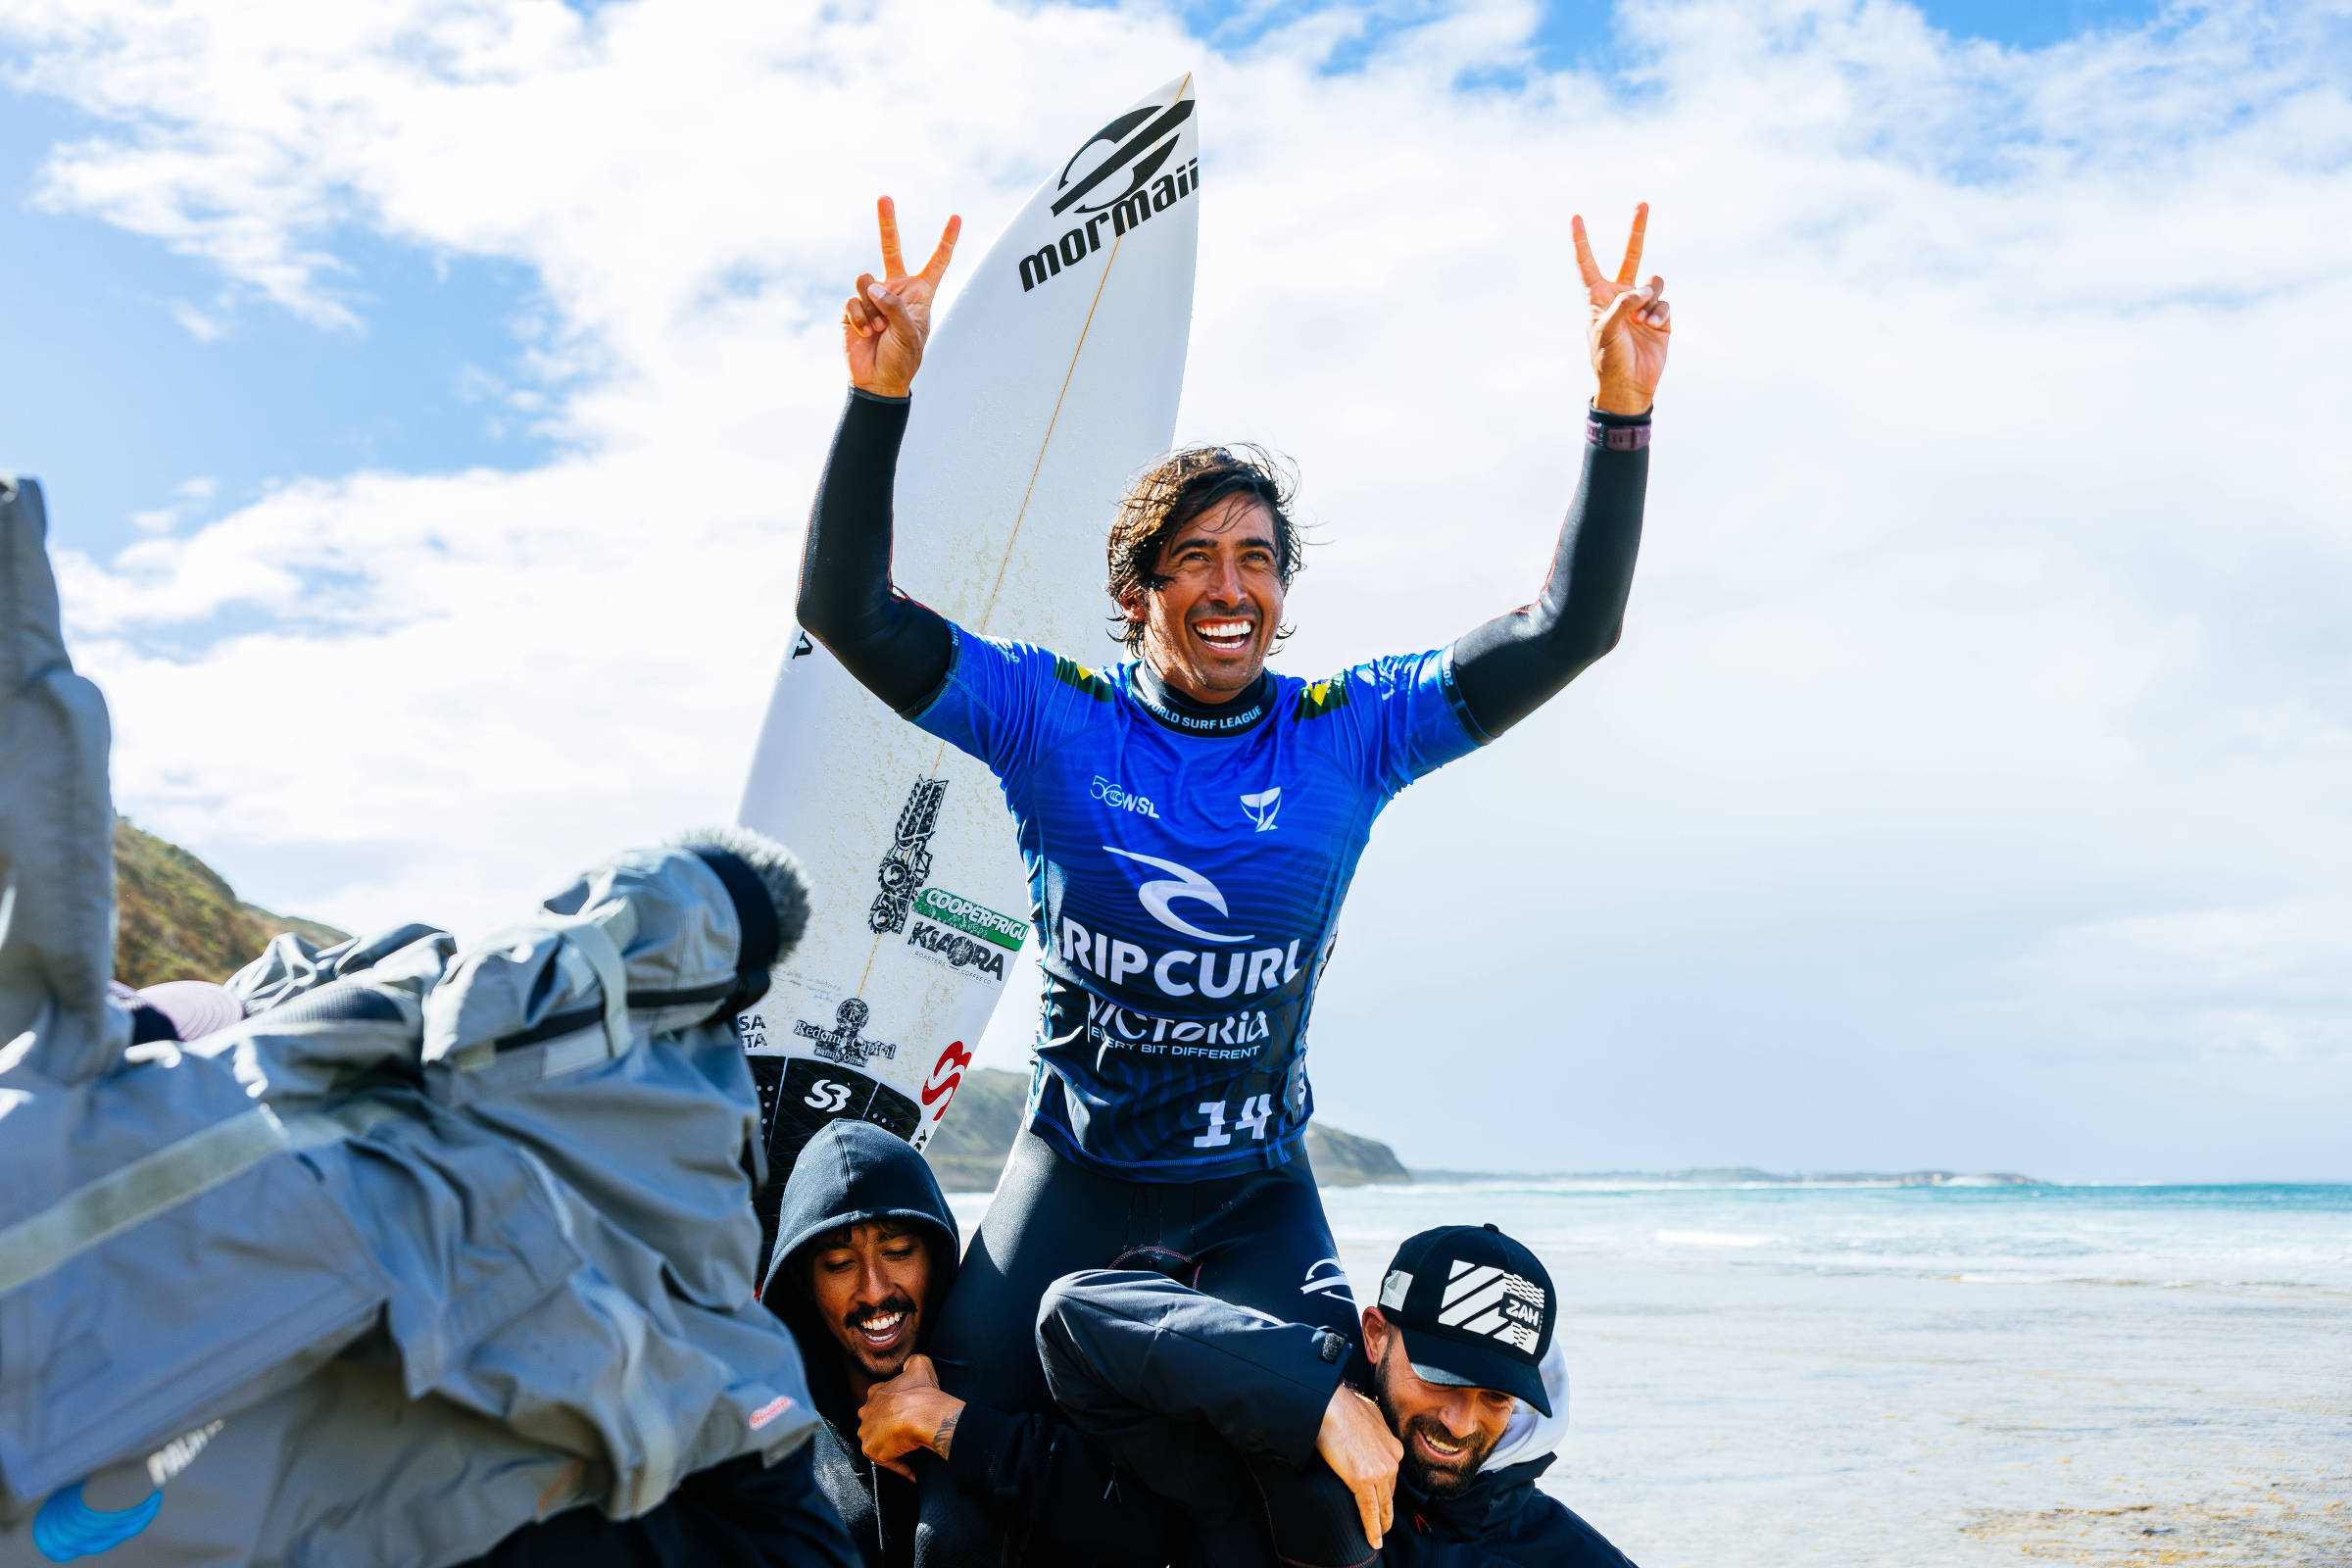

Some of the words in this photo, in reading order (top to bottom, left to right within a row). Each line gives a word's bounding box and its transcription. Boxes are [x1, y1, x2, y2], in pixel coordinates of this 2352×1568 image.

[1019, 157, 1199, 292] mormaii
[1181, 716, 1217, 729] SURF
[1219, 706, 1262, 729] LEAGUE
[1121, 791, 1160, 819] WSL
[926, 890, 1029, 941] COOPERFRIGU
[1062, 916, 1149, 986] RIP
[1153, 938, 1300, 999] CURL
[1091, 1025, 1137, 1051] EVERY
[1141, 1044, 1168, 1055] BIT
[1171, 1045, 1261, 1059] DIFFERENT
[1194, 1094, 1273, 1149] 14
